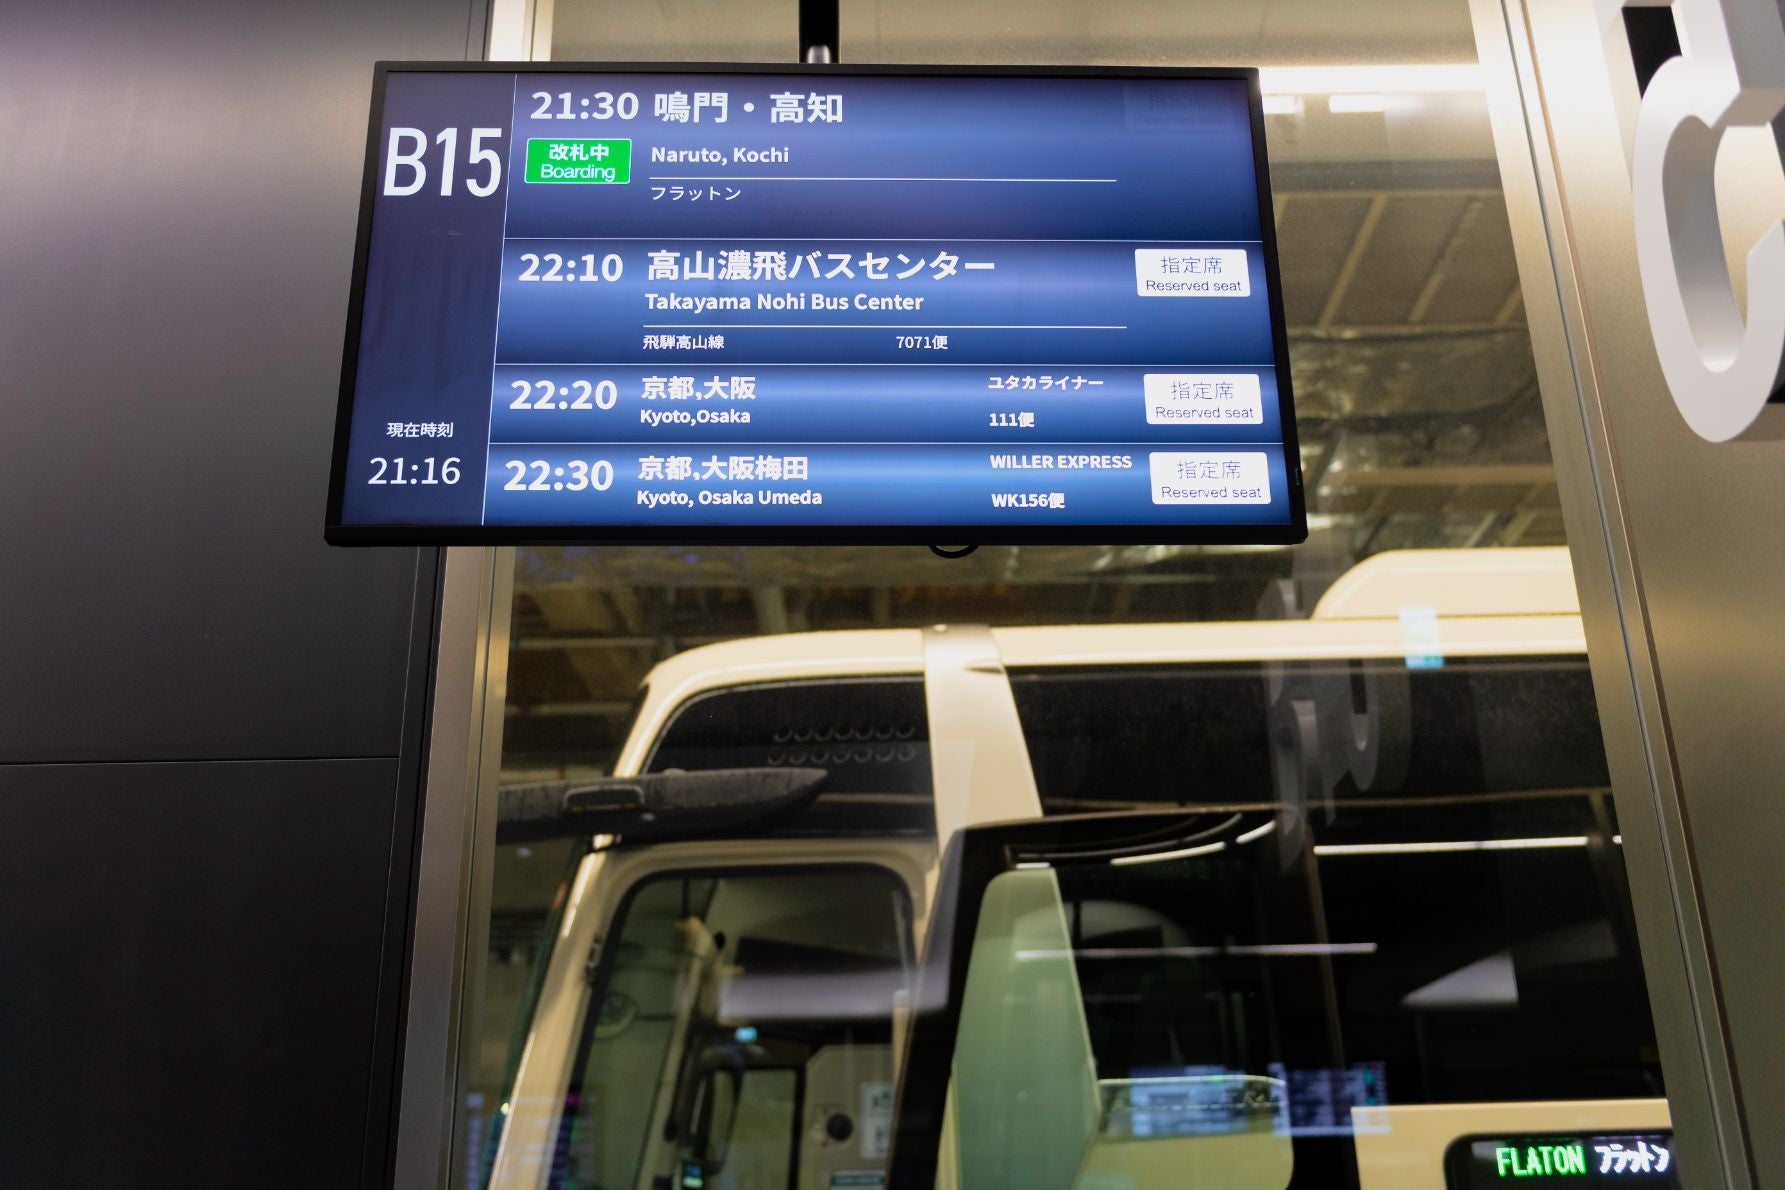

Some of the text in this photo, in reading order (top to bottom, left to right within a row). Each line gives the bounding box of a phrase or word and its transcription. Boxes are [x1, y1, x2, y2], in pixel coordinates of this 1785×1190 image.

[530, 91, 640, 120] 21:30
[653, 91, 843, 124] 鳴門・高知
[549, 143, 609, 161] 改札中
[651, 146, 789, 166] Naruto, Kochi
[383, 127, 502, 198] B15
[540, 164, 616, 182] Boarding
[651, 186, 741, 202] フラットン
[518, 253, 624, 283] 22:10
[647, 249, 996, 281] 高山濃飛バスセンター
[1160, 255, 1223, 275] 指定席
[1146, 280, 1242, 292] Reserved seat
[644, 292, 925, 312] Takayama Nohi Bus Center
[642, 334, 725, 350] 飛騨高山線
[895, 334, 949, 351] 7071便
[641, 375, 757, 401] 京都,大阪
[987, 375, 1104, 392] ユタカライナー
[1170, 381, 1234, 401] 指定席
[509, 379, 618, 410] 22:20
[640, 408, 751, 427] Kyoto,Osaka
[989, 412, 1035, 428] 111便
[1155, 406, 1254, 419] Reserved seat
[386, 421, 454, 438] 現在時刻
[367, 457, 461, 485] 21:16
[638, 455, 809, 481] 京都,大阪梅田
[990, 454, 1133, 469] WILLER EXPRESS
[1177, 460, 1241, 480] 指定席
[503, 460, 615, 491] 22:30
[637, 489, 823, 507] Kyoto, Osaka Umeda
[991, 492, 1066, 509] WK156便
[1161, 485, 1262, 499] Reserved seat
[1495, 1145, 1587, 1177] FLATON
